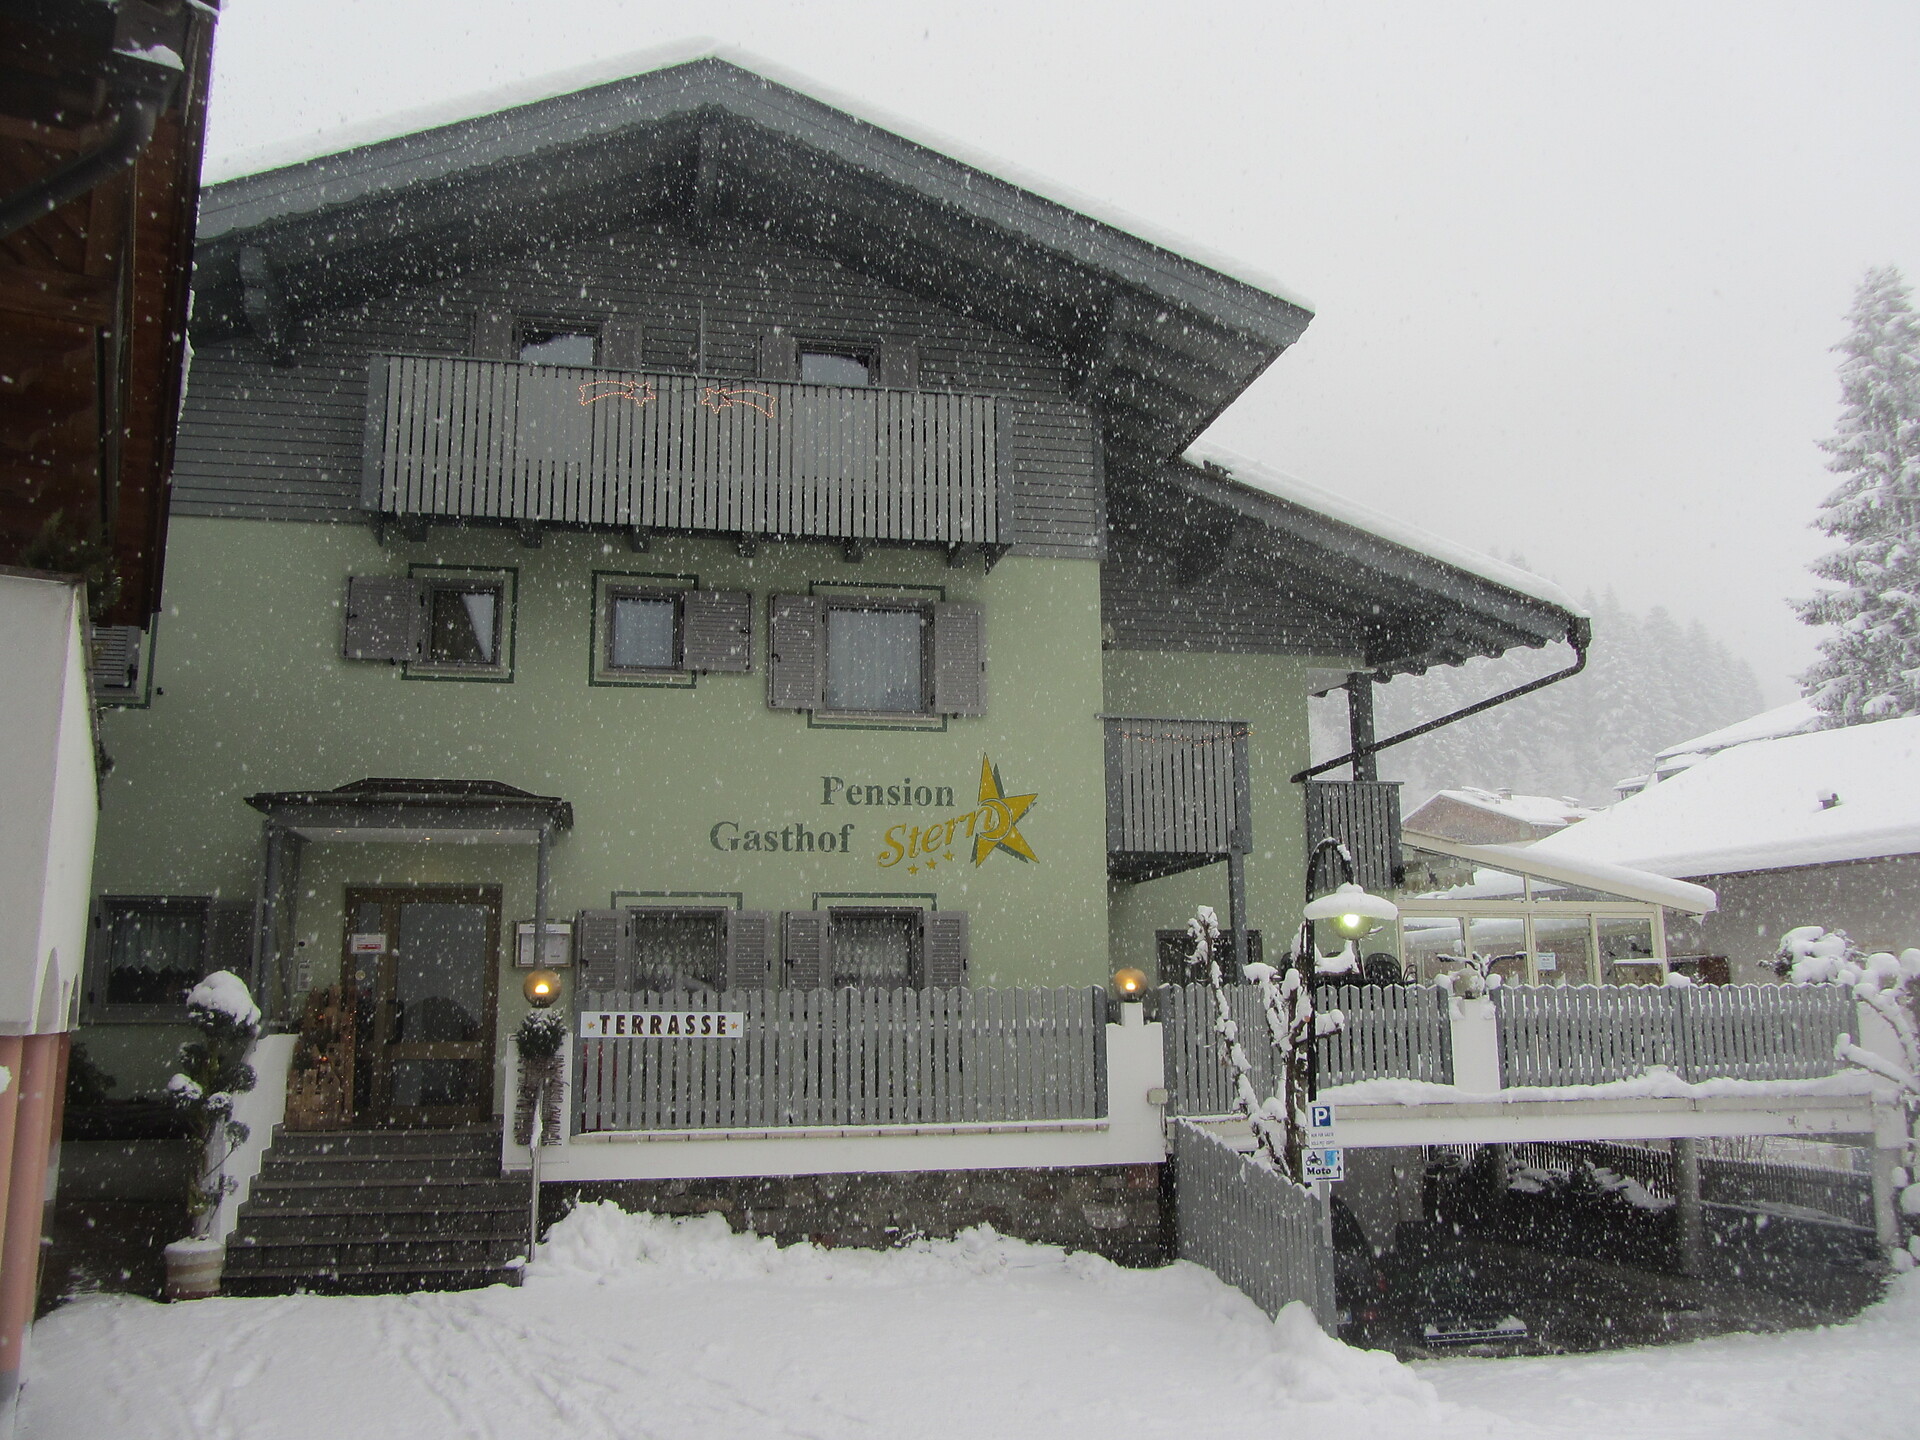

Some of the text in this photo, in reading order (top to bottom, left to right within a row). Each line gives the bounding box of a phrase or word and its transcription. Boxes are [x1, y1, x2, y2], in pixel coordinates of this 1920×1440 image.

[820, 775, 956, 807] Pension
[709, 803, 998, 868] Gasthof Stern
[599, 1014, 727, 1035] TERRASSE
[1314, 1107, 1328, 1127] P
[1306, 1167, 1332, 1176] Moto
